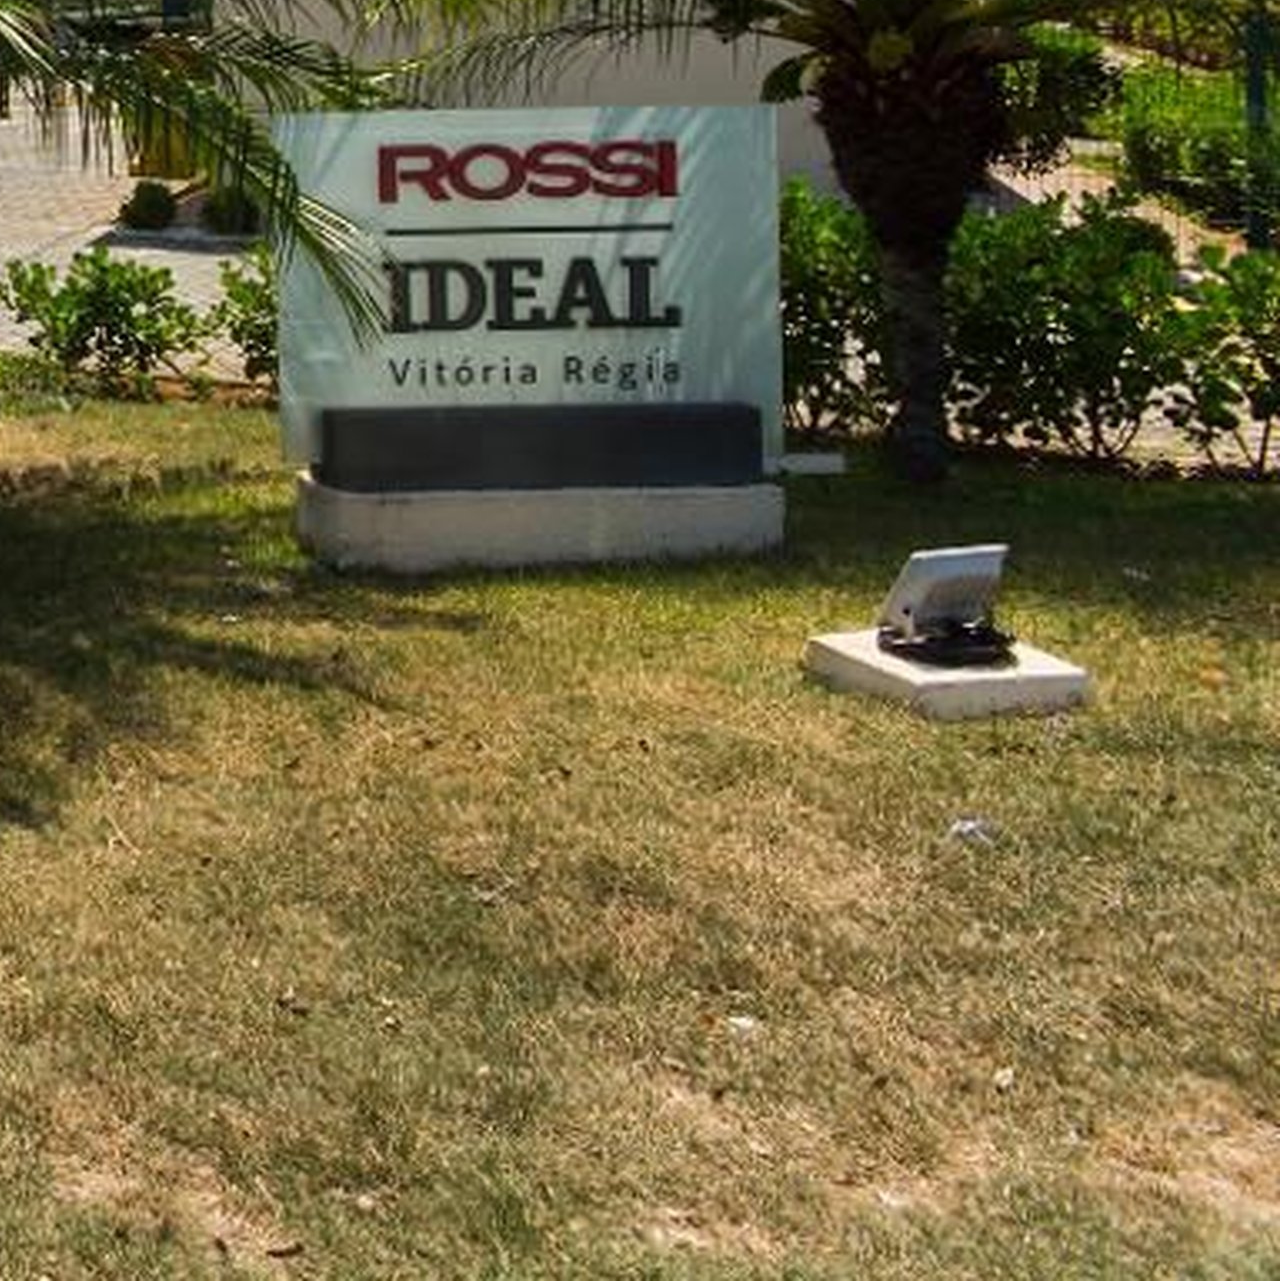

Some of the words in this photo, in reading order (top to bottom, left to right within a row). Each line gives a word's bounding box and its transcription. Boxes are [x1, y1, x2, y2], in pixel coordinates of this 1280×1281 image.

[377, 139, 680, 203] ROSSI
[383, 255, 683, 334] IDEAL
[389, 355, 538, 388] Vitória
[563, 349, 682, 392] Régia
